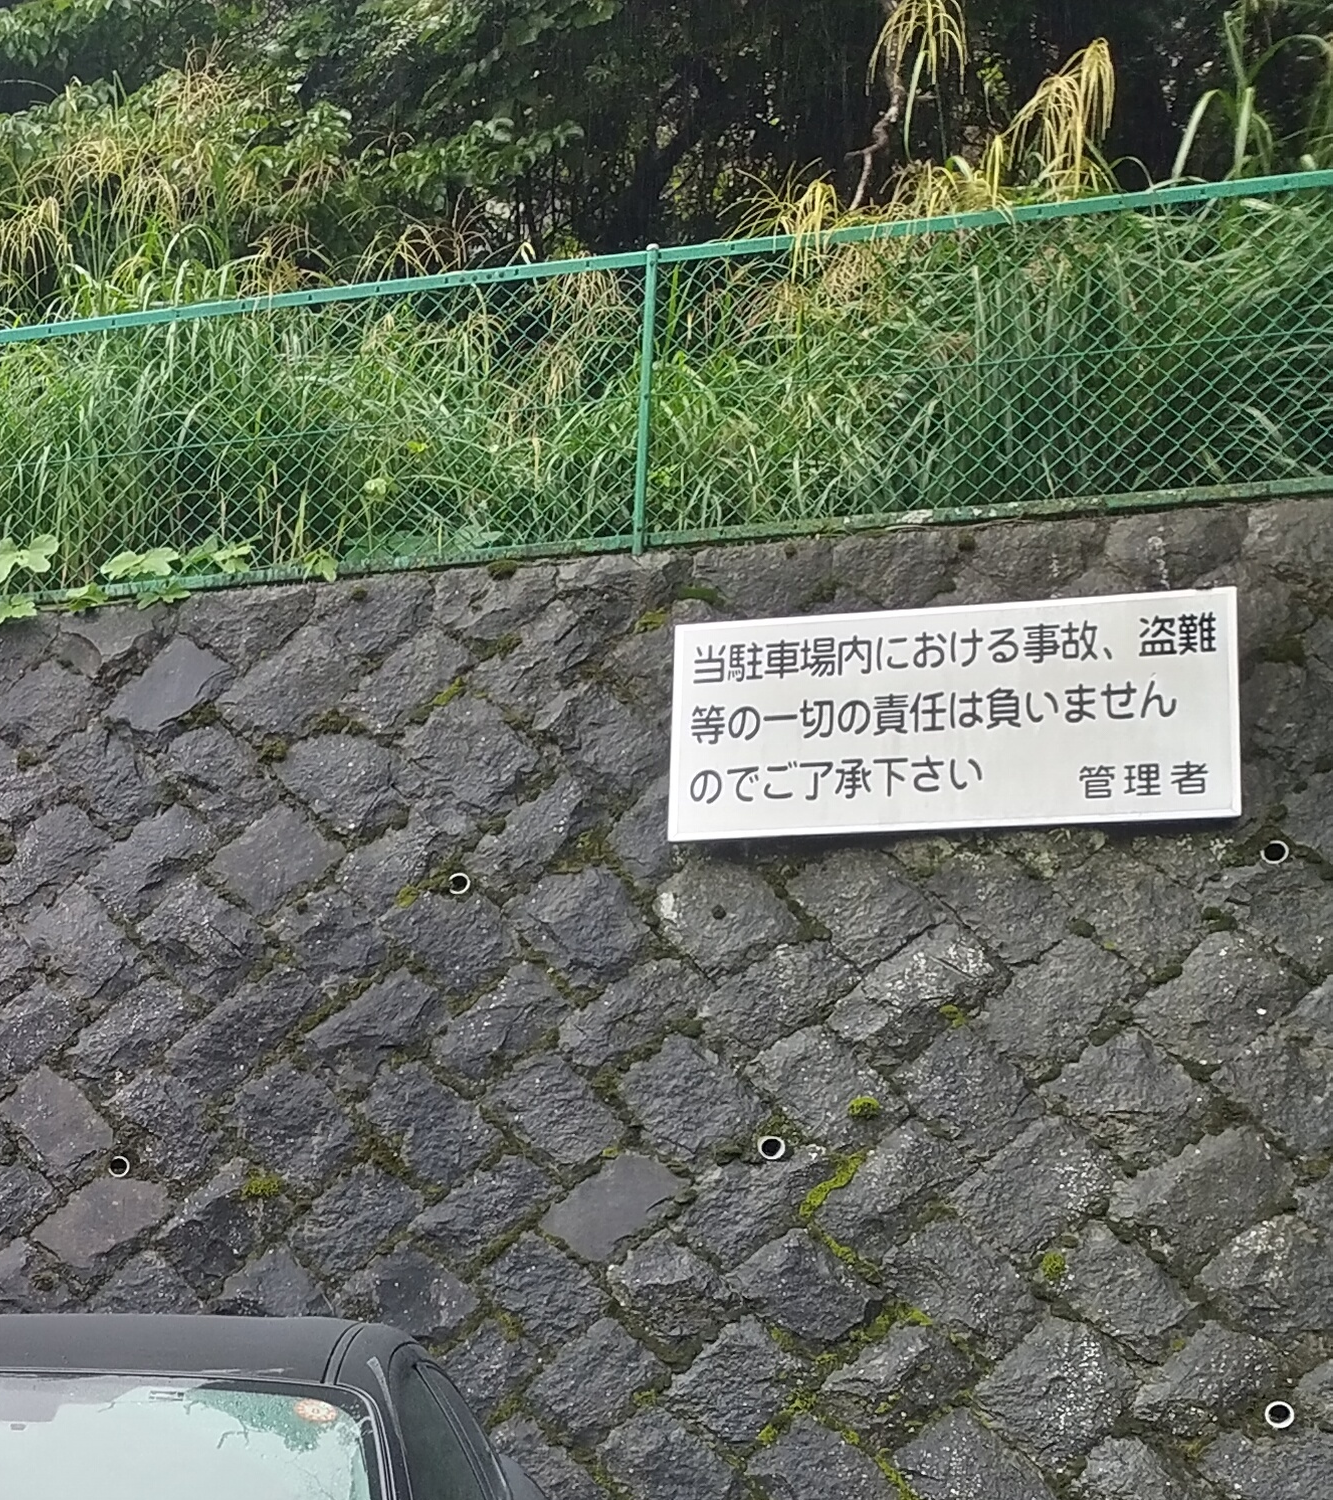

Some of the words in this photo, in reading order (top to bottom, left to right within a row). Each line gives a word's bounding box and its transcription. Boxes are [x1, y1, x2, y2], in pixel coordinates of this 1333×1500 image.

[692, 611, 1217, 684] 当駐車場内における事故、盗難
[690, 679, 1177, 745] 等の一切の責任は負いません
[689, 755, 983, 804] のでご了承下さい
[1078, 760, 1209, 799] 管理者
